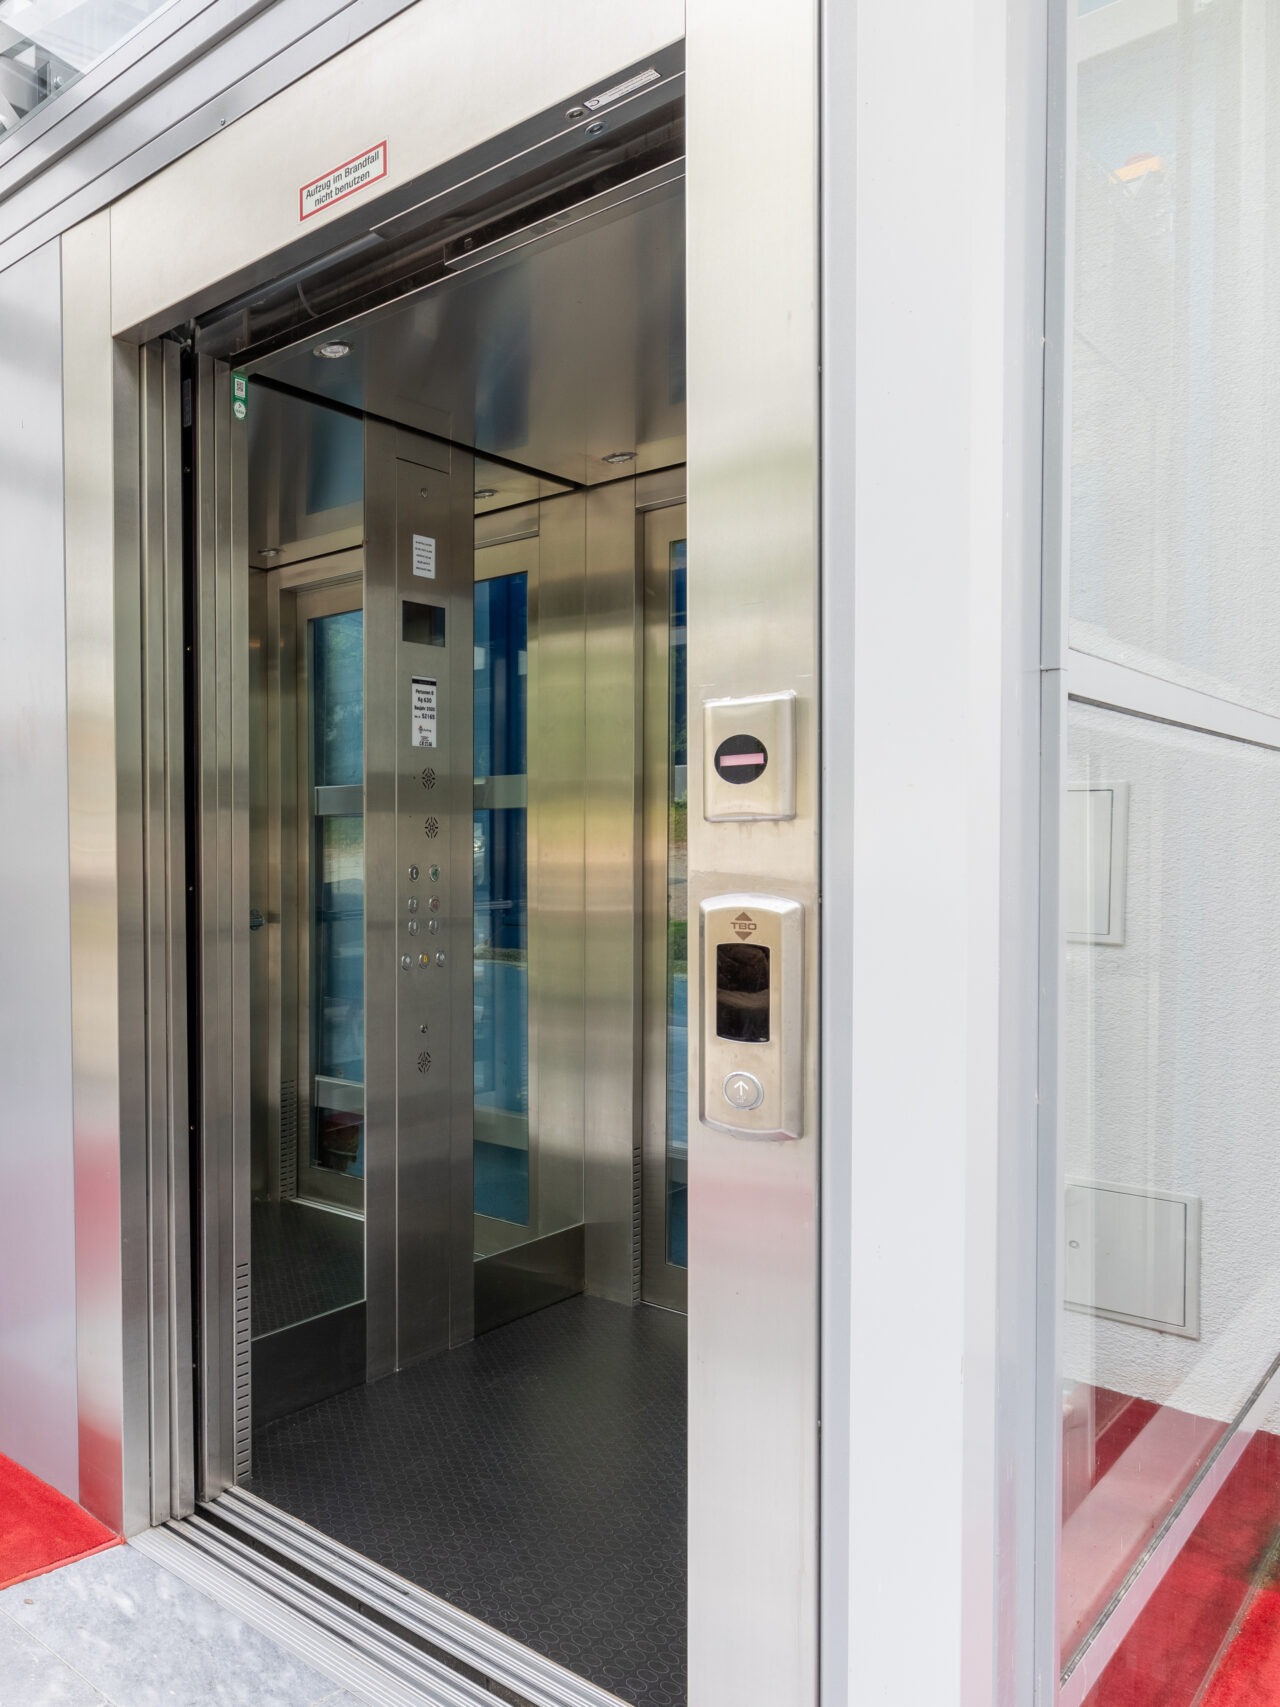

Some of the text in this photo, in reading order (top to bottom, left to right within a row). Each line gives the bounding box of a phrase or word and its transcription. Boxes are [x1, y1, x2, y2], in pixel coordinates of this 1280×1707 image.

[305, 150, 379, 199] Aufzug im Brandfall
[314, 170, 370, 207] nicht benutzen
